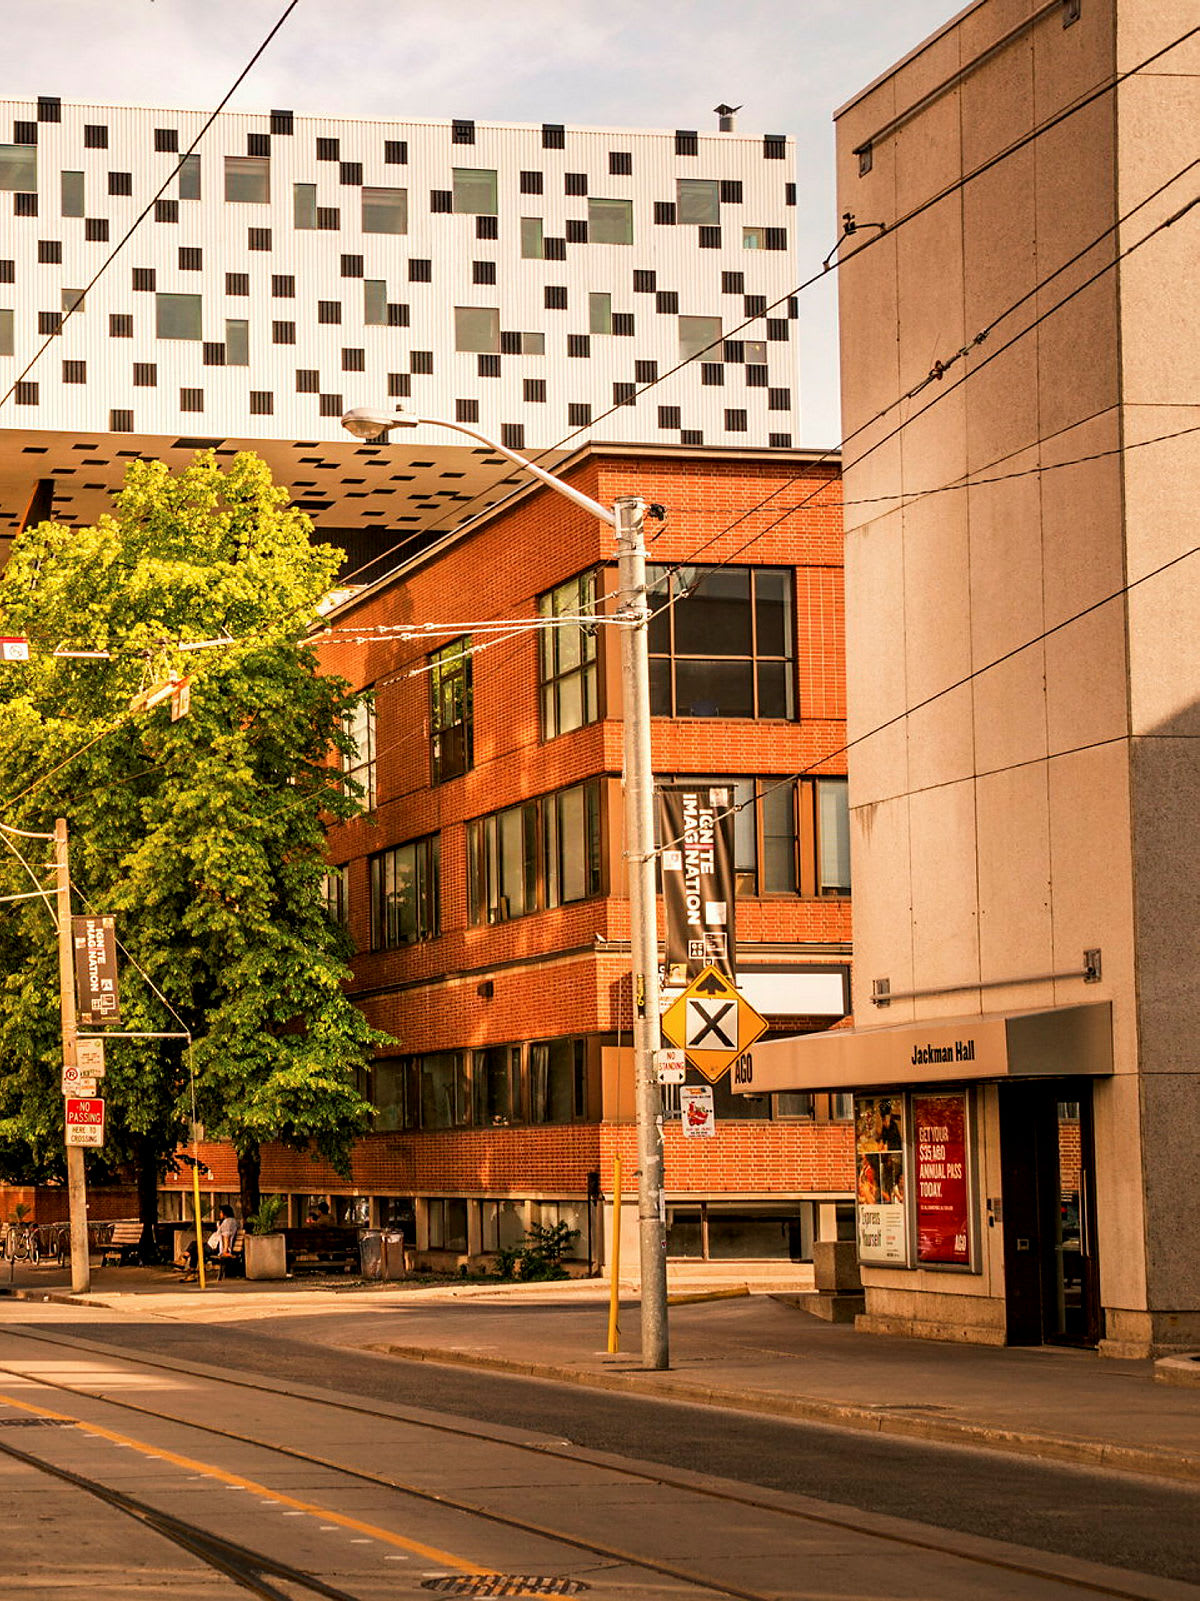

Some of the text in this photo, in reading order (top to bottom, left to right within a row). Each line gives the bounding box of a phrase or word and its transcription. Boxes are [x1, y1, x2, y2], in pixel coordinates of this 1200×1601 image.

[699, 808, 715, 875] IGNITE
[682, 793, 702, 925] IMAGINATION
[86, 920, 100, 992] IMAGINATION
[95, 927, 107, 965] IGNITE
[666, 1051, 676, 1060] NO
[911, 1039, 976, 1066] Jackman Hall
[658, 1061, 685, 1071] STANDING
[734, 1052, 754, 1085] AGO
[68, 1111, 102, 1124] PASSING
[79, 1101, 91, 1113] NO
[919, 1163, 963, 1180] ANNUAL PASS
[919, 1181, 943, 1198] TODAY.
